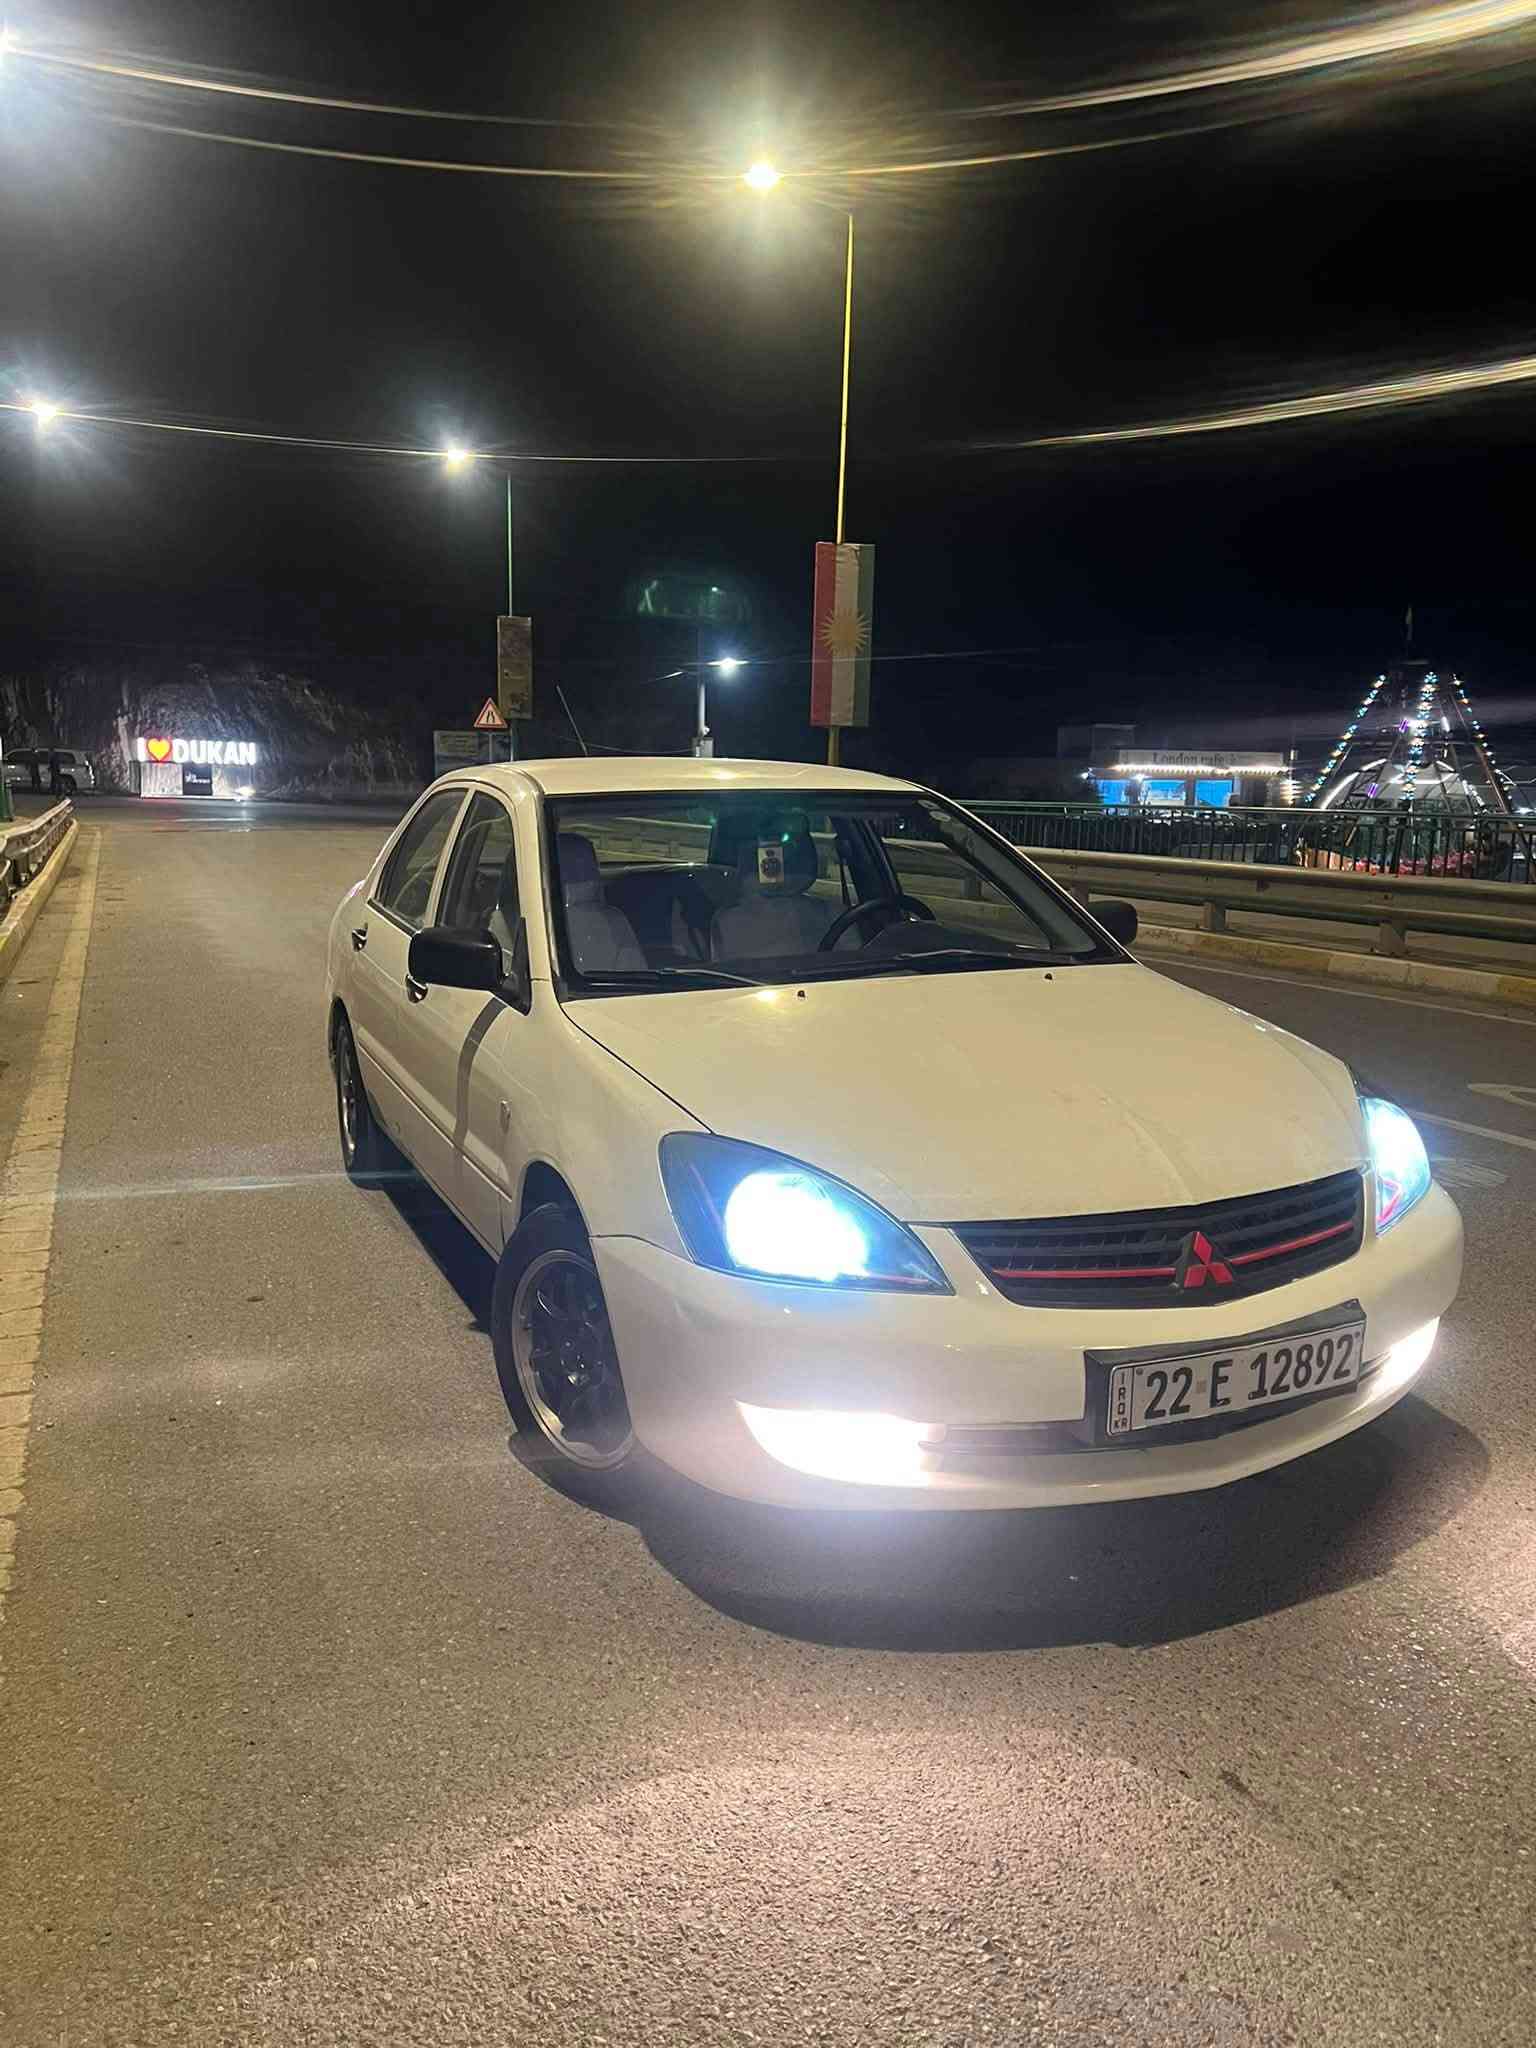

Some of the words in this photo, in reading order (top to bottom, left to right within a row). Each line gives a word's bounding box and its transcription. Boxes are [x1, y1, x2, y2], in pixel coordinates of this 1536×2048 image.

[137, 737, 145, 762] I
[172, 738, 256, 765] DUKAN
[1152, 752, 1198, 766] London
[1144, 1367, 1193, 1419] 22
[1210, 1359, 1233, 1408] E
[1248, 1334, 1354, 1401] 12892
